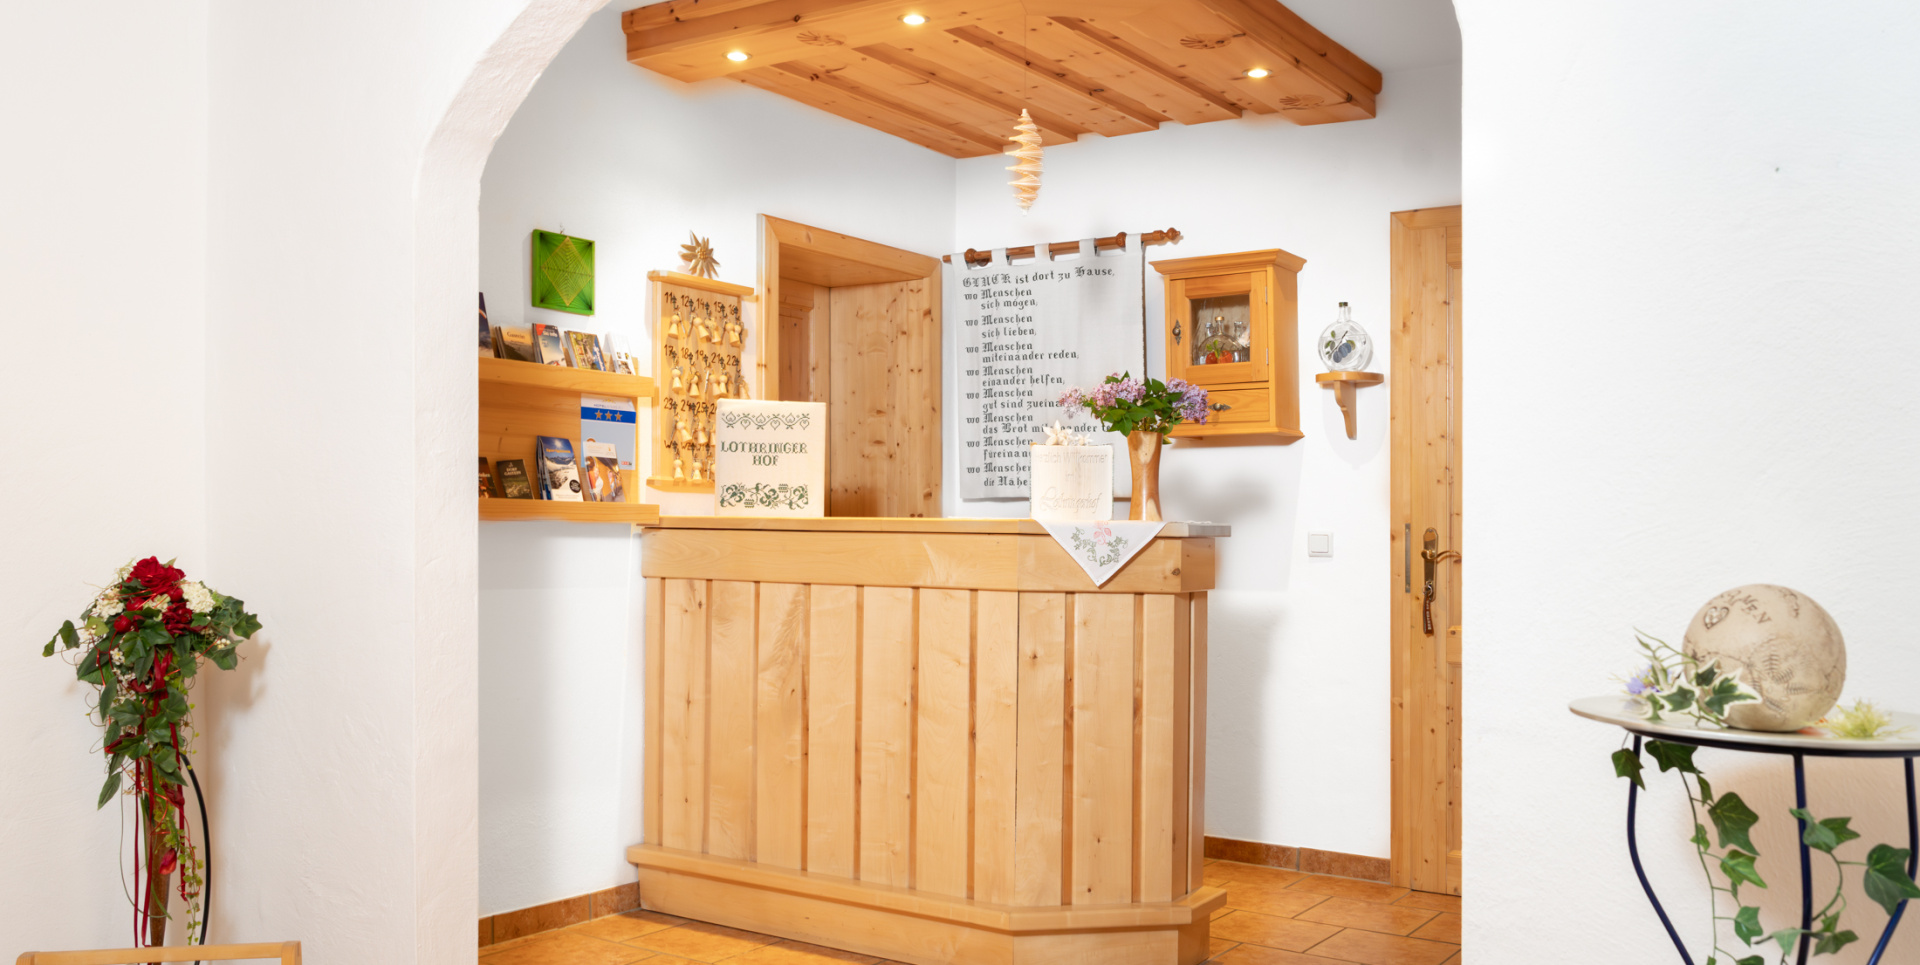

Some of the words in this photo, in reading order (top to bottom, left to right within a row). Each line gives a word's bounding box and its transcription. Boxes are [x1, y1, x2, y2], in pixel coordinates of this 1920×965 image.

[1015, 274, 1029, 284] ist
[1032, 270, 1055, 282] dort
[1058, 272, 1071, 283] zu
[964, 293, 978, 301] wo
[981, 288, 1033, 300] Menschen
[681, 295, 690, 308] 12
[981, 299, 1000, 310] sich
[982, 314, 1033, 326] Menschen
[981, 328, 1000, 339] sich
[982, 341, 1033, 353] Menschen
[982, 351, 1044, 363] miteinander
[966, 369, 980, 377] wo
[982, 365, 1033, 377] Menschen
[982, 376, 1026, 387] einander
[982, 388, 1033, 400] Menschen
[710, 402, 717, 415] 2
[982, 401, 997, 413] gut
[1001, 400, 1023, 409] sind
[1027, 400, 1063, 411] zueina
[966, 416, 980, 424] wo
[983, 412, 1033, 424] Menschen
[983, 425, 998, 434] das
[1001, 422, 1028, 433] Brot
[720, 440, 808, 454] LOTHRINGER
[966, 440, 980, 448] wo
[752, 455, 779, 467] HOF
[983, 449, 1031, 461] füreinan
[984, 477, 994, 487] die
